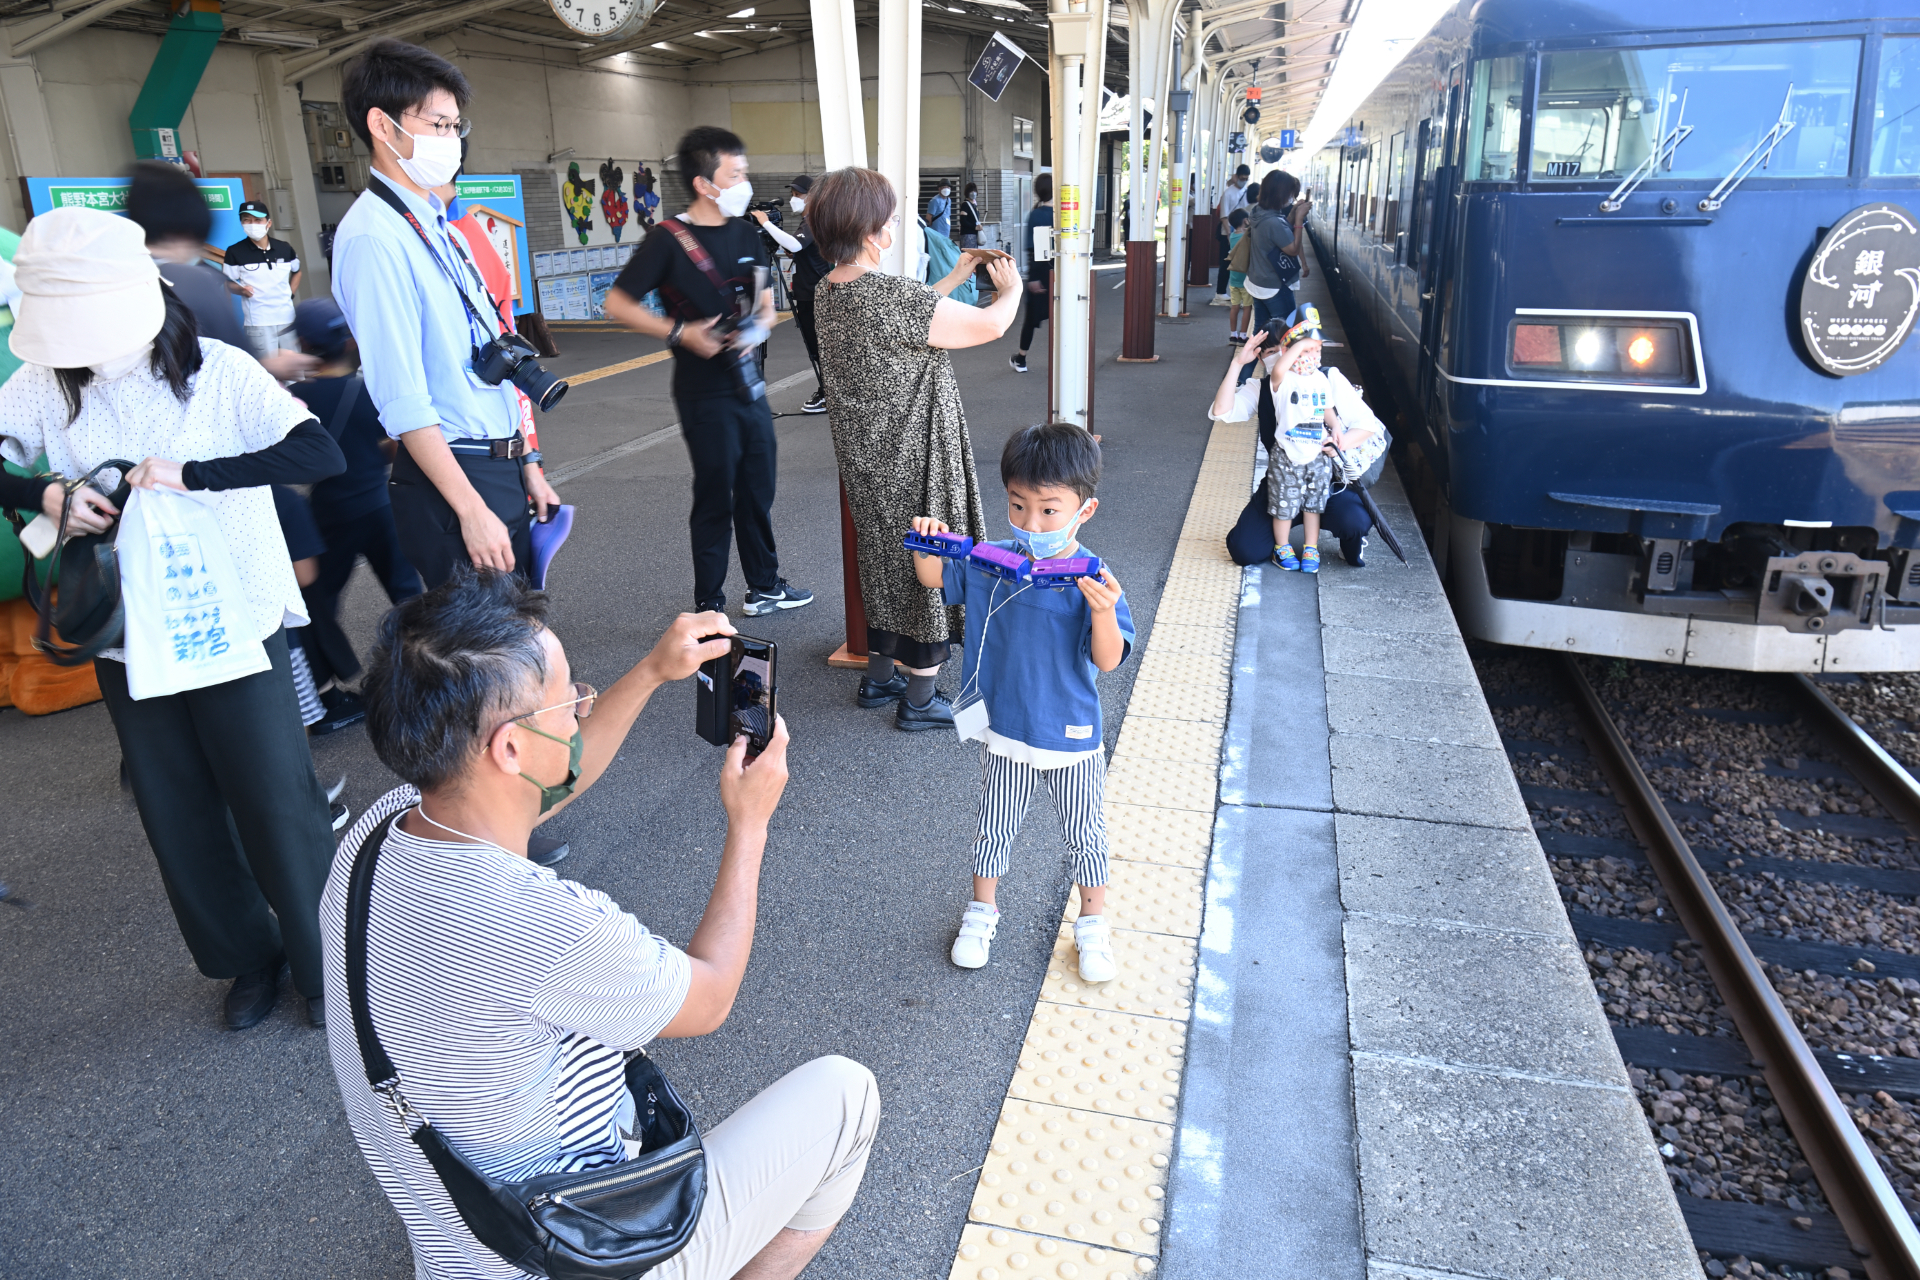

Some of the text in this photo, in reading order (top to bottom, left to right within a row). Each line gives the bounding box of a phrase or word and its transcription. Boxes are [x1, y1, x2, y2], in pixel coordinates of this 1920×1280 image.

[576, 8, 585, 23] 7
[593, 12, 601, 27] 6
[608, 6, 617, 21] 5
[1284, 132, 1290, 146] 1
[1547, 162, 1580, 176] M117
[403, 211, 431, 246] PENTAX
[1847, 249, 1885, 309] 銀河
[173, 626, 230, 662] 新宮
